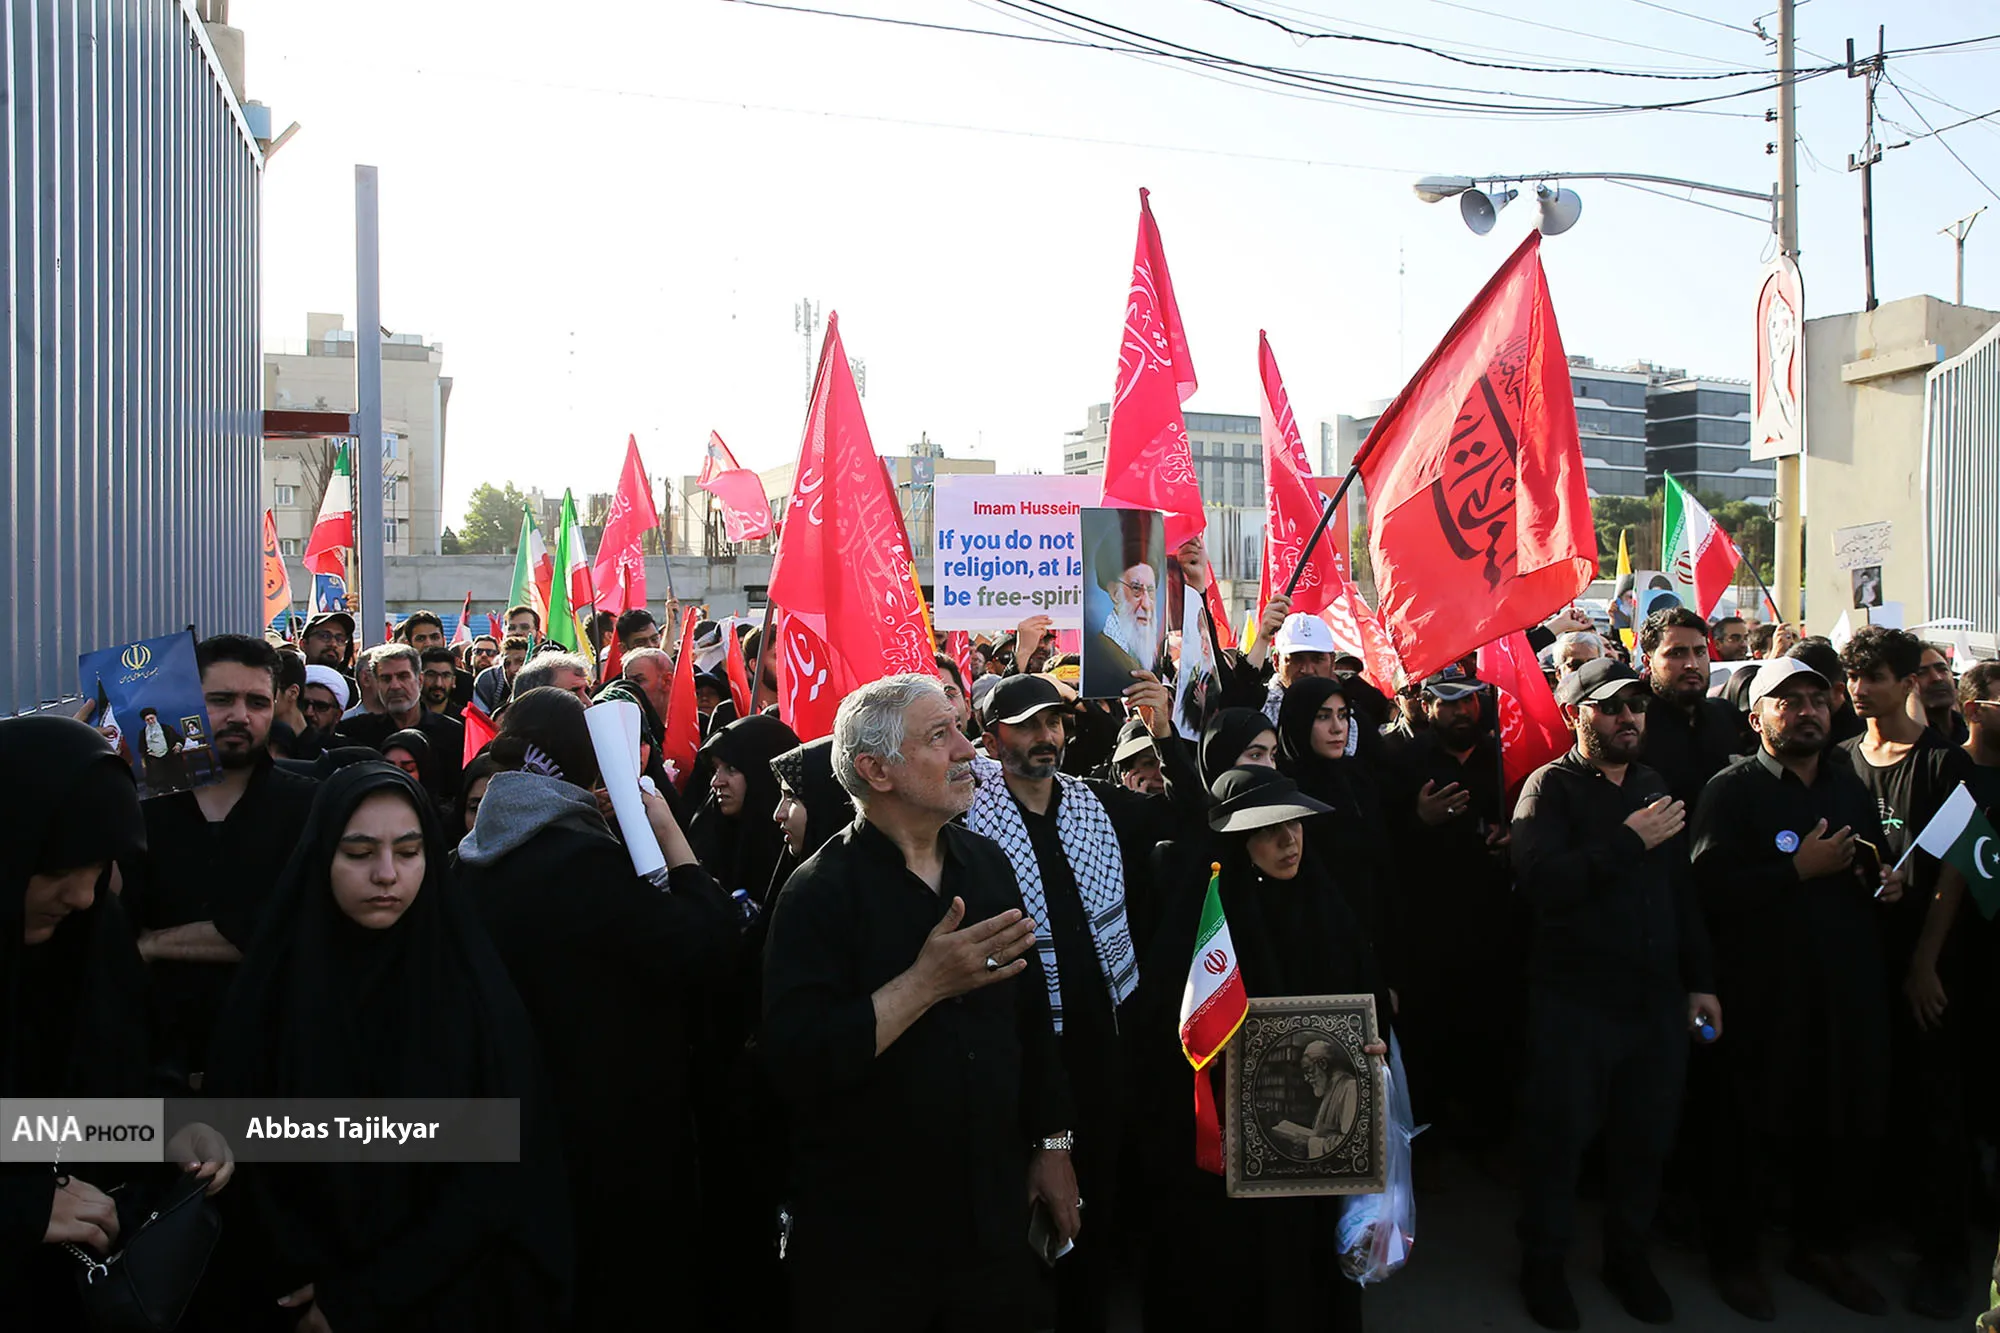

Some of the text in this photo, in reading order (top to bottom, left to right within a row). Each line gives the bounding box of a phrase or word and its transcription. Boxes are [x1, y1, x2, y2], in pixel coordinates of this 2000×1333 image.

[973, 500, 1080, 516] Imam Hussein
[938, 528, 1075, 556] If you do not
[943, 556, 1035, 581] religion,
[1038, 558, 1060, 577] at
[943, 584, 1082, 610] be free-spiri
